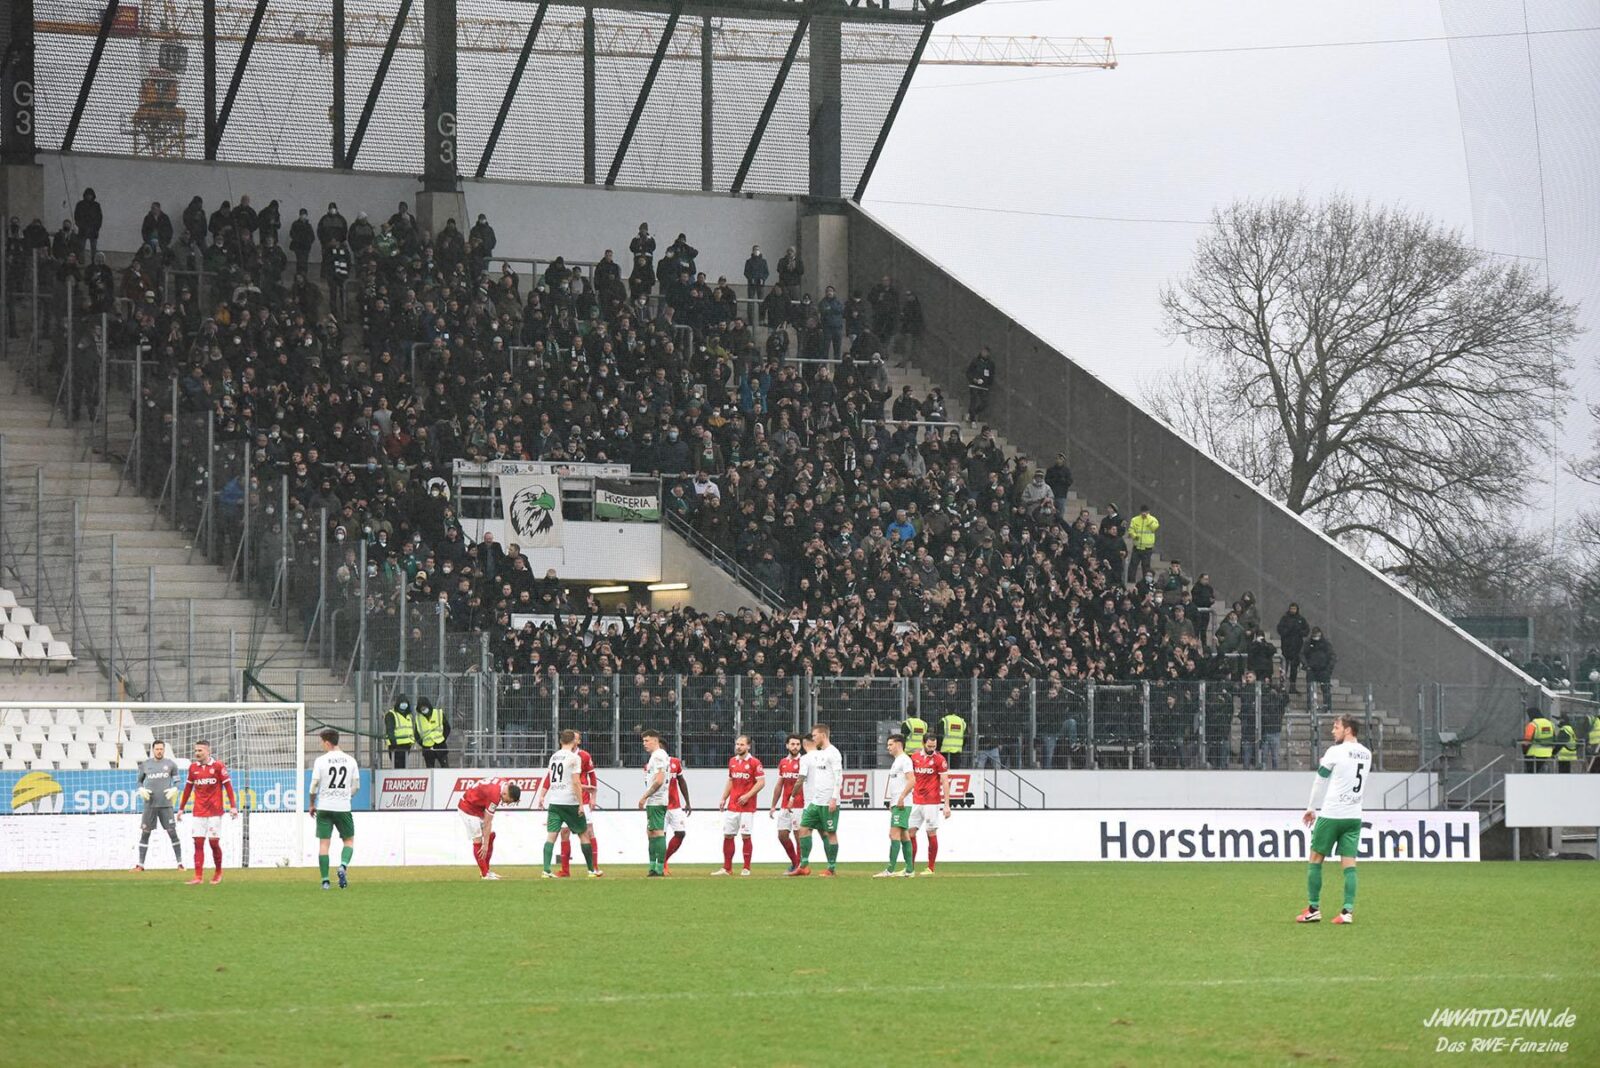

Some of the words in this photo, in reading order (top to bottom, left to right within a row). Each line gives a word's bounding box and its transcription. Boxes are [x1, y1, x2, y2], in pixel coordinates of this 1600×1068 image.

[16, 110, 31, 135] 3
[440, 140, 454, 164] 3
[328, 766, 348, 789] 22
[551, 762, 564, 783] 29
[1352, 763, 1364, 793] 5
[384, 779, 426, 791] TRANSPORTE
[1100, 821, 1336, 858] Horstman
[1356, 820, 1471, 859] GmbH
